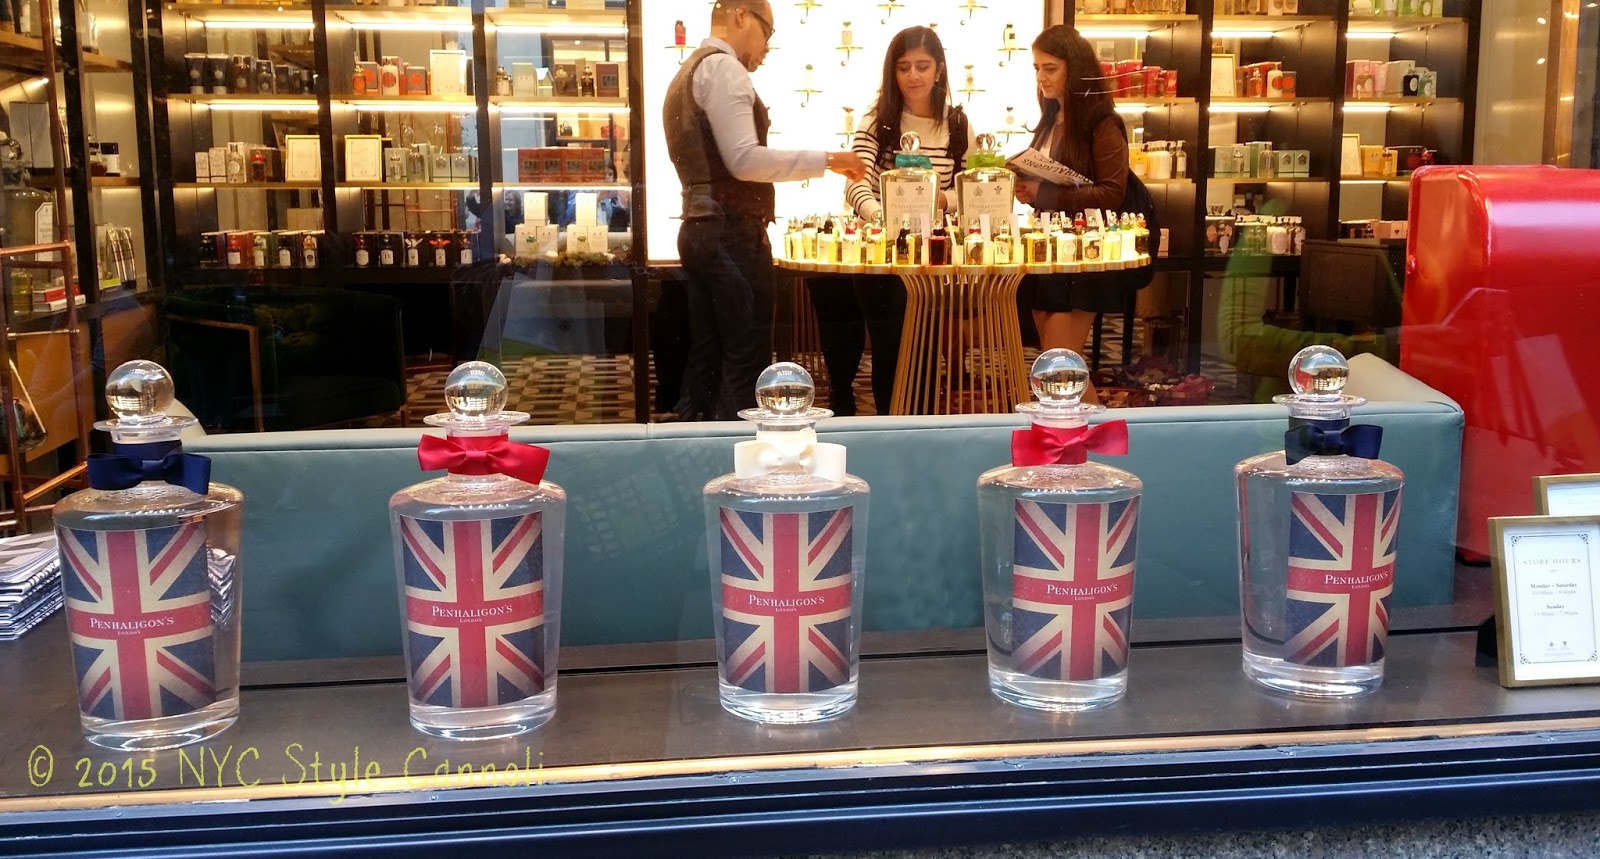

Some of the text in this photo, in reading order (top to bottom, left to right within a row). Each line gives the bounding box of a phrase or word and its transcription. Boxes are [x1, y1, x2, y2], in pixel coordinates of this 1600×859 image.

[1523, 557, 1581, 566] STORE HOURS
[1325, 571, 1388, 585] PENHALIGON'S
[1046, 583, 1118, 596] PENHALIGON'S
[748, 594, 825, 607] PENHALIGON'S
[432, 605, 513, 618] PENHALIGON'S
[90, 616, 174, 630] PENHALIGON'S
